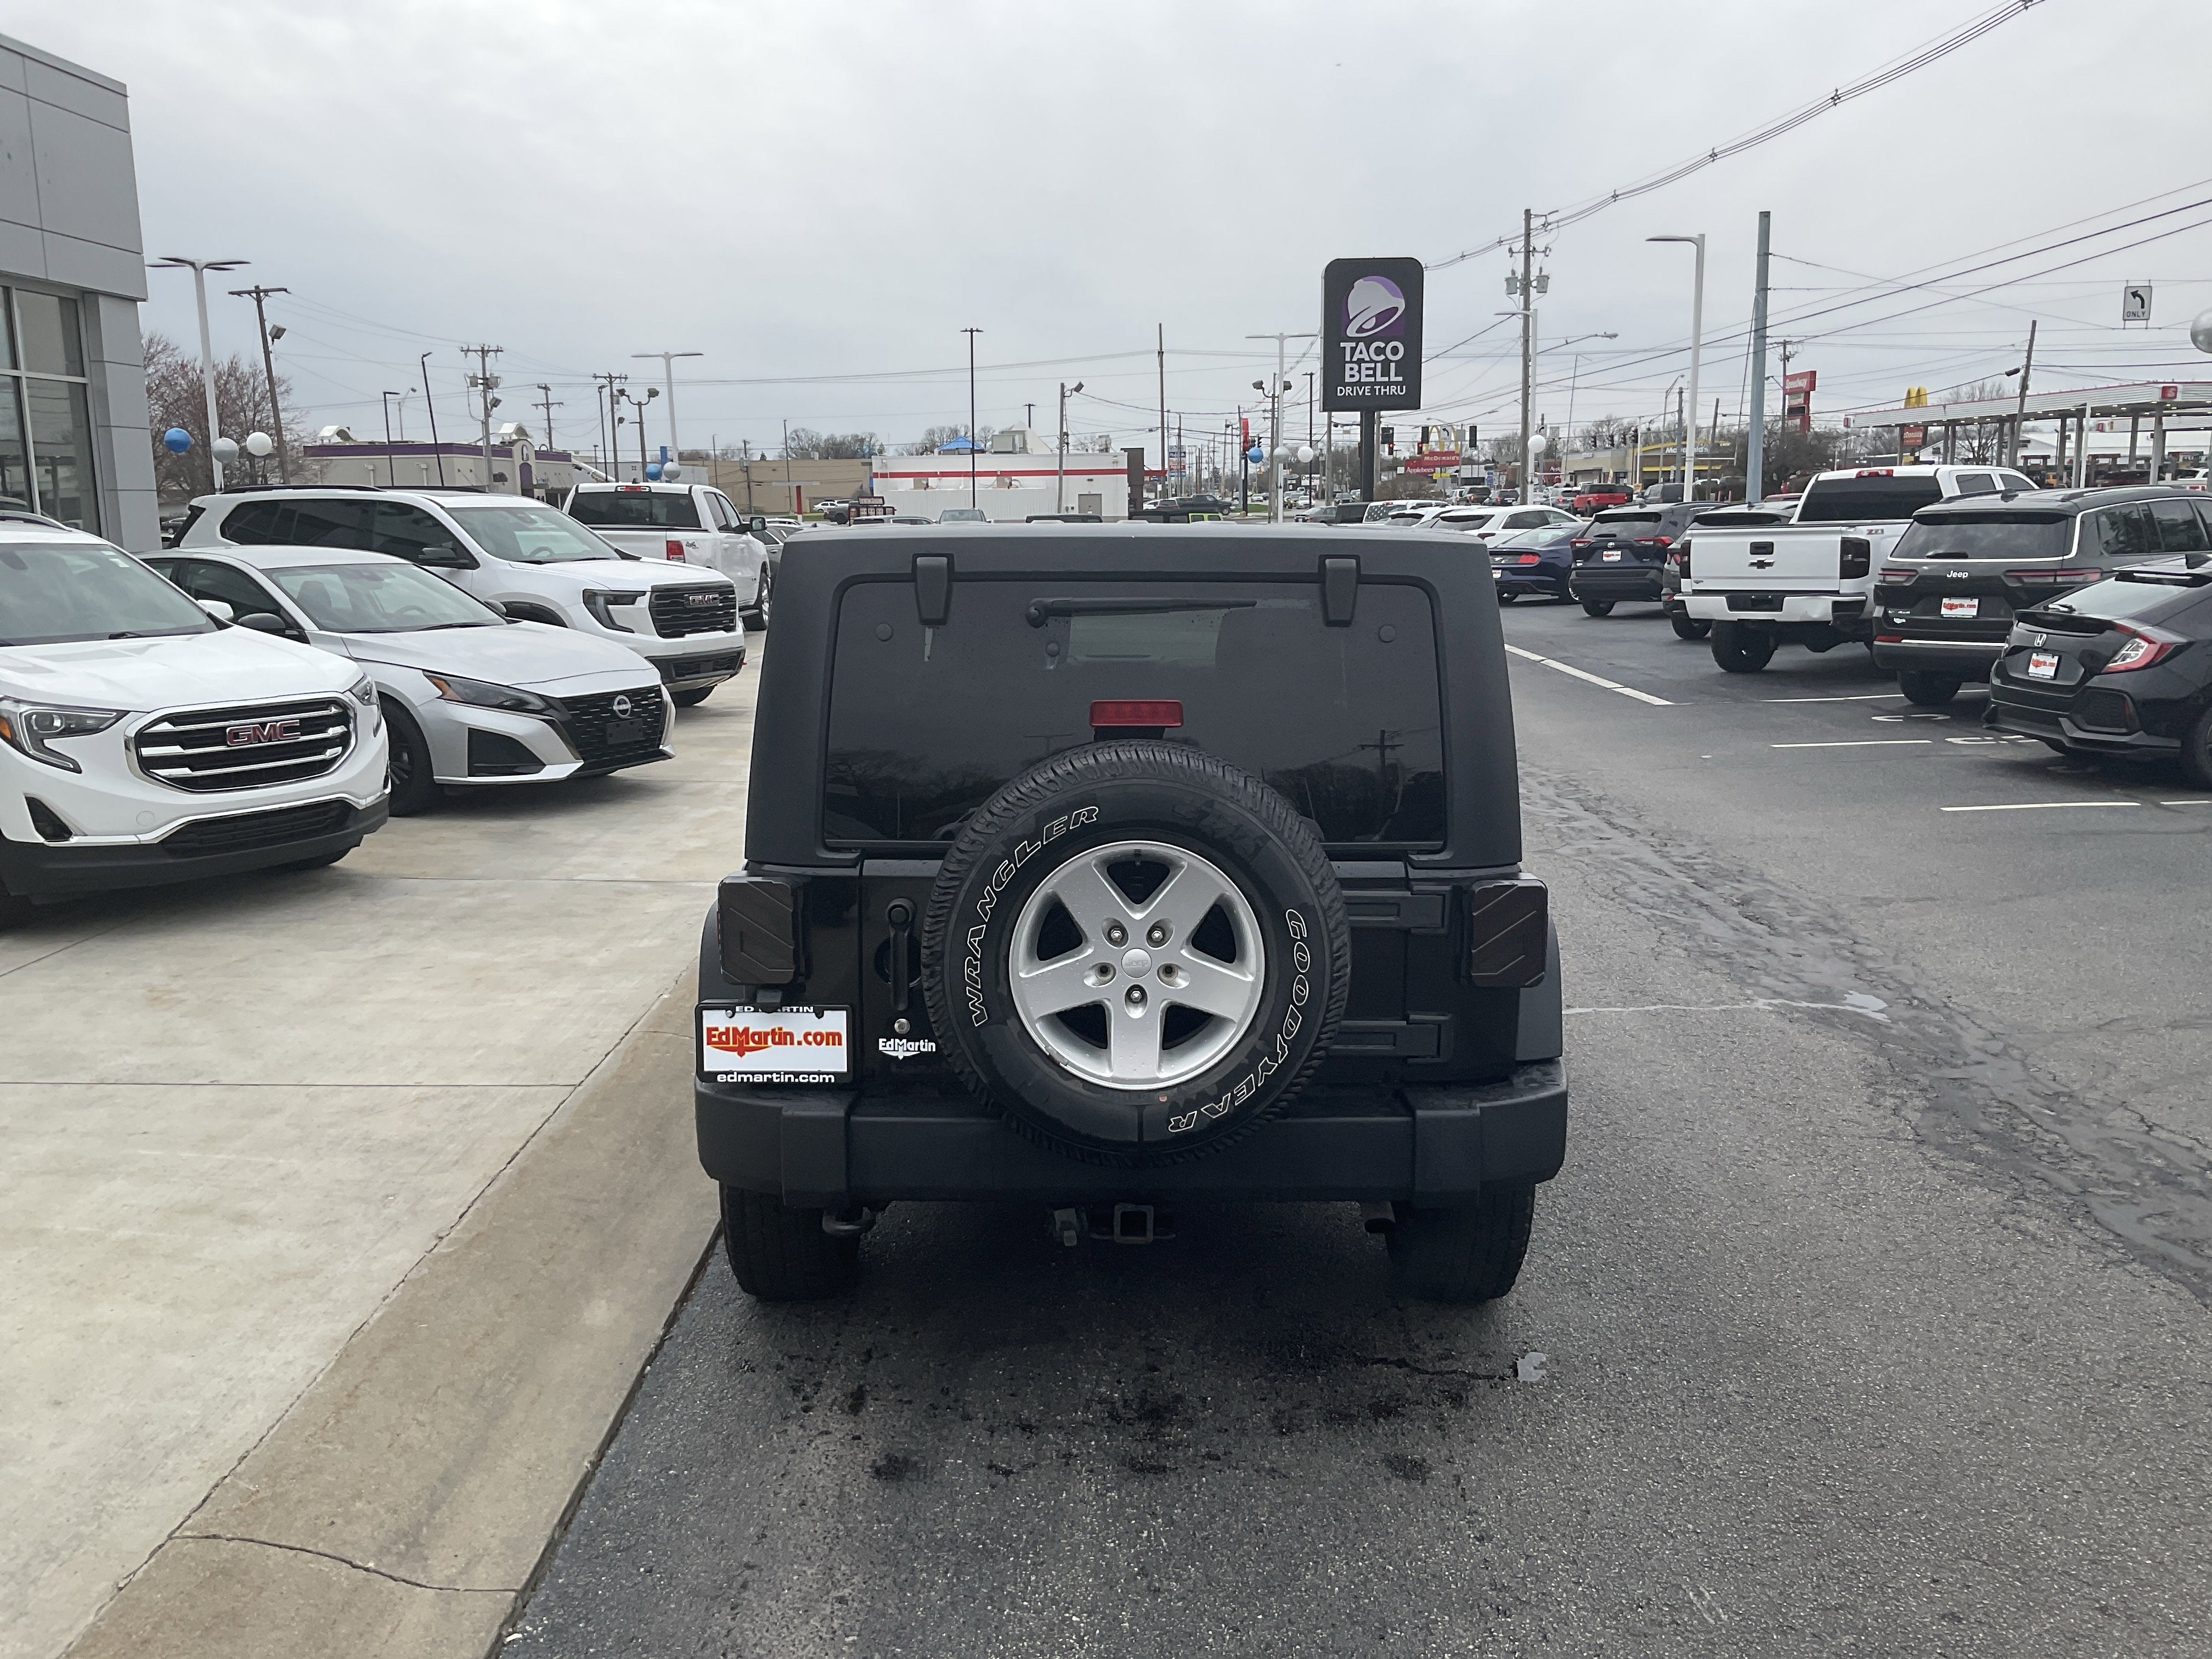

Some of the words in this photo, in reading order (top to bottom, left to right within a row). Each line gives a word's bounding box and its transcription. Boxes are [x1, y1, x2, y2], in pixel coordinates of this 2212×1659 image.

[1340, 341, 1404, 361] TACO
[1345, 363, 1402, 382] BELL
[1338, 386, 1371, 396] DRIVE
[1374, 386, 1406, 395] THRU
[1947, 570, 1968, 579] Jeep
[689, 594, 720, 605] GMC
[226, 719, 301, 746] GMC
[964, 806, 1098, 1026] WRANGLER
[1169, 909, 1311, 1132] GOODYEAR
[706, 1026, 843, 1047] EdMartin.com
[879, 1039, 936, 1052] EdMartin
[717, 1071, 835, 1083] edmartin.com
